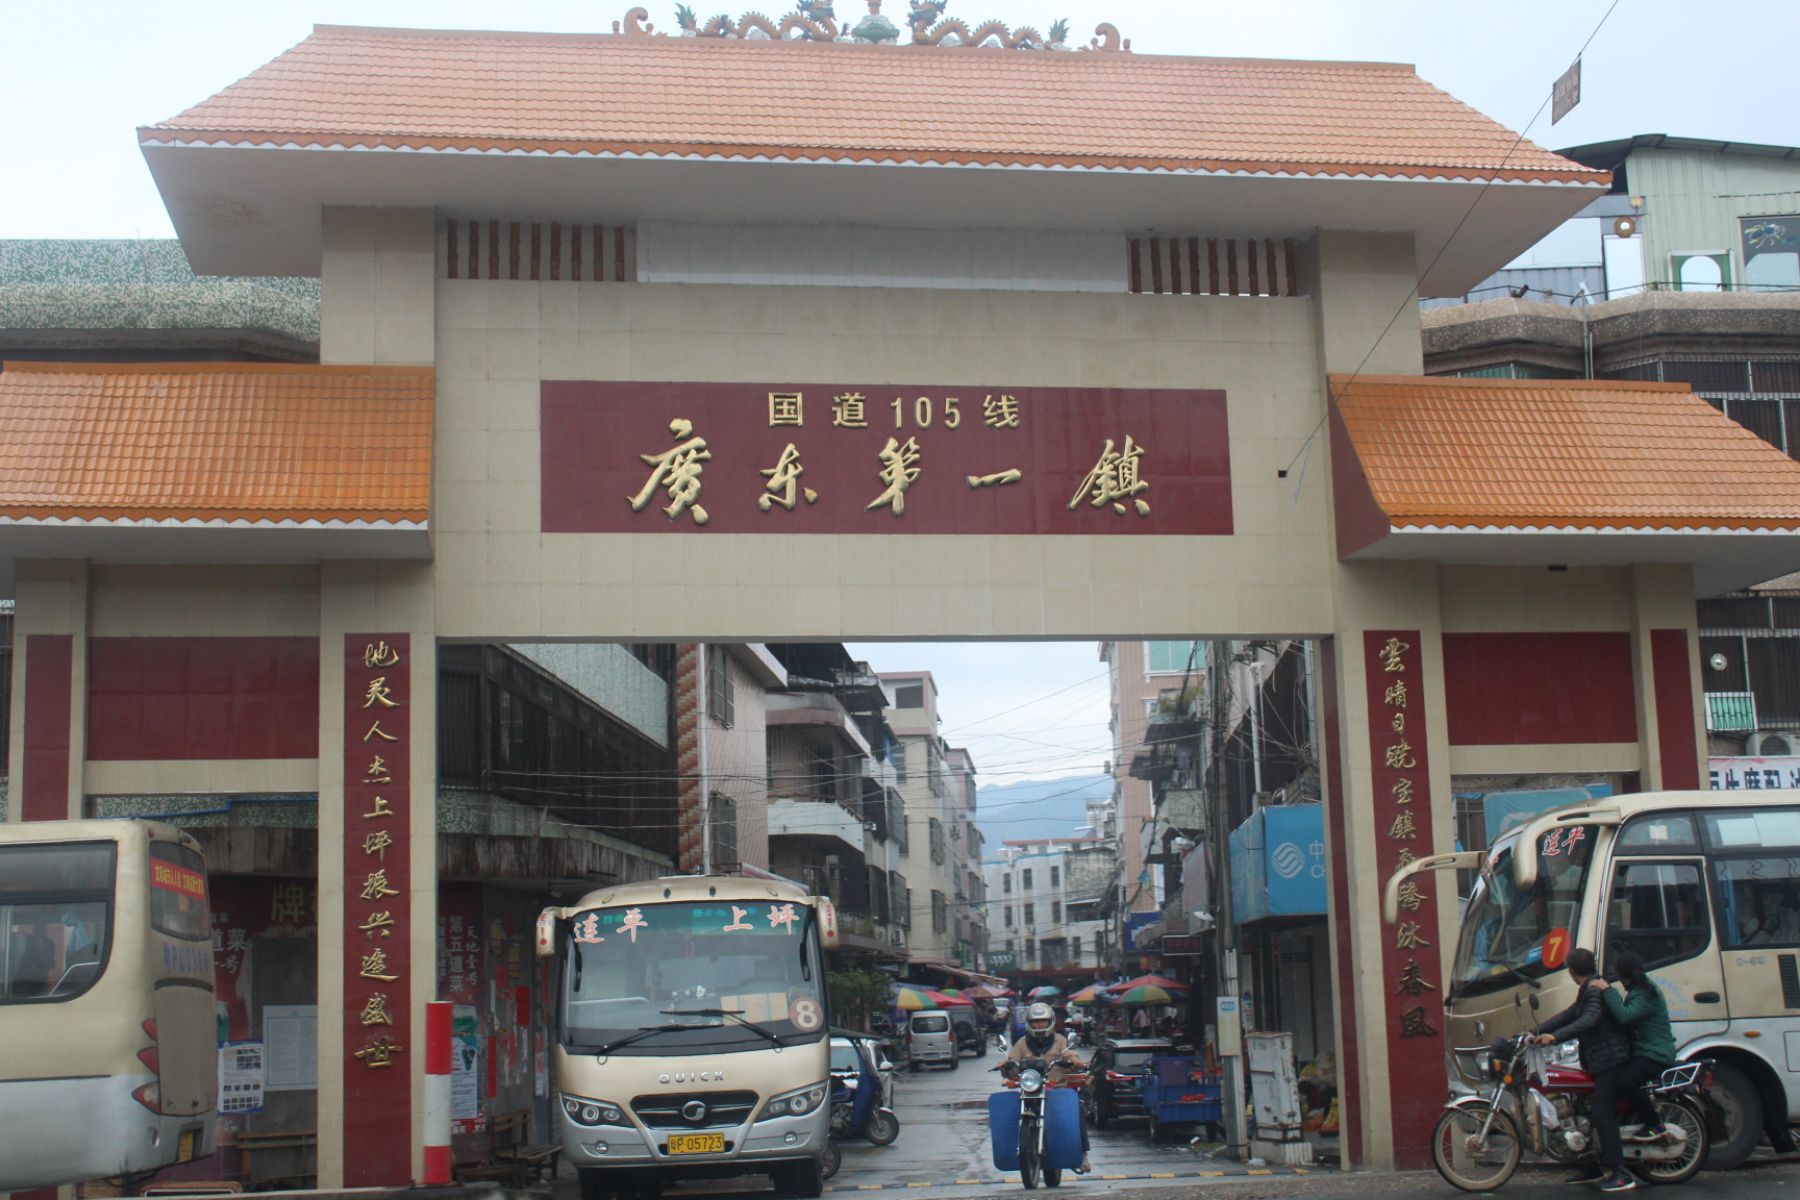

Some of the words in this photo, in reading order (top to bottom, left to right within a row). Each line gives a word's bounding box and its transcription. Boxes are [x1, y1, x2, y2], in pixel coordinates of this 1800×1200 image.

[1549, 936, 1563, 962] 7
[795, 999, 818, 1029] 8
[658, 1071, 724, 1084] QUICK
